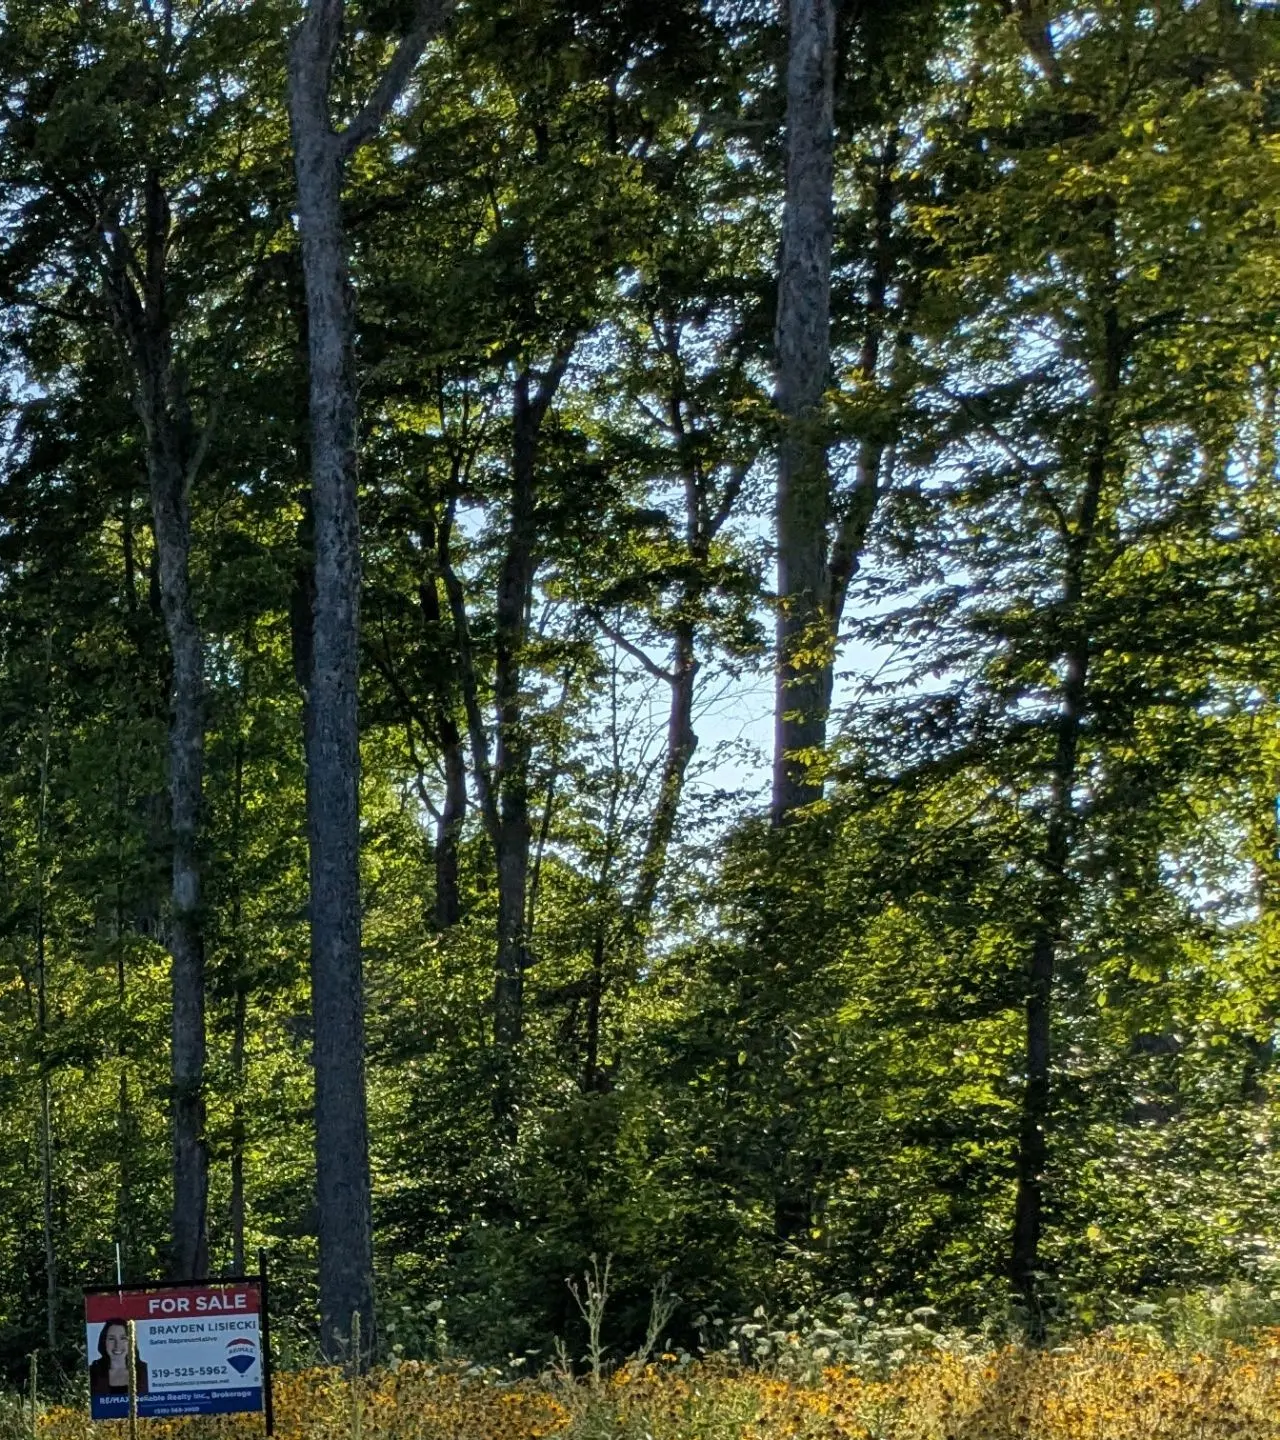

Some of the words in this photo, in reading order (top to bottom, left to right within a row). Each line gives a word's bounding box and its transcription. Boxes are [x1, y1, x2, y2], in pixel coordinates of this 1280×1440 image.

[149, 1297, 190, 1314] FOR
[196, 1293, 247, 1311] SALE
[149, 1323, 205, 1335] BRAYDEN
[208, 1320, 256, 1332] LISIECKI
[151, 1365, 229, 1378] 519-525-5962
